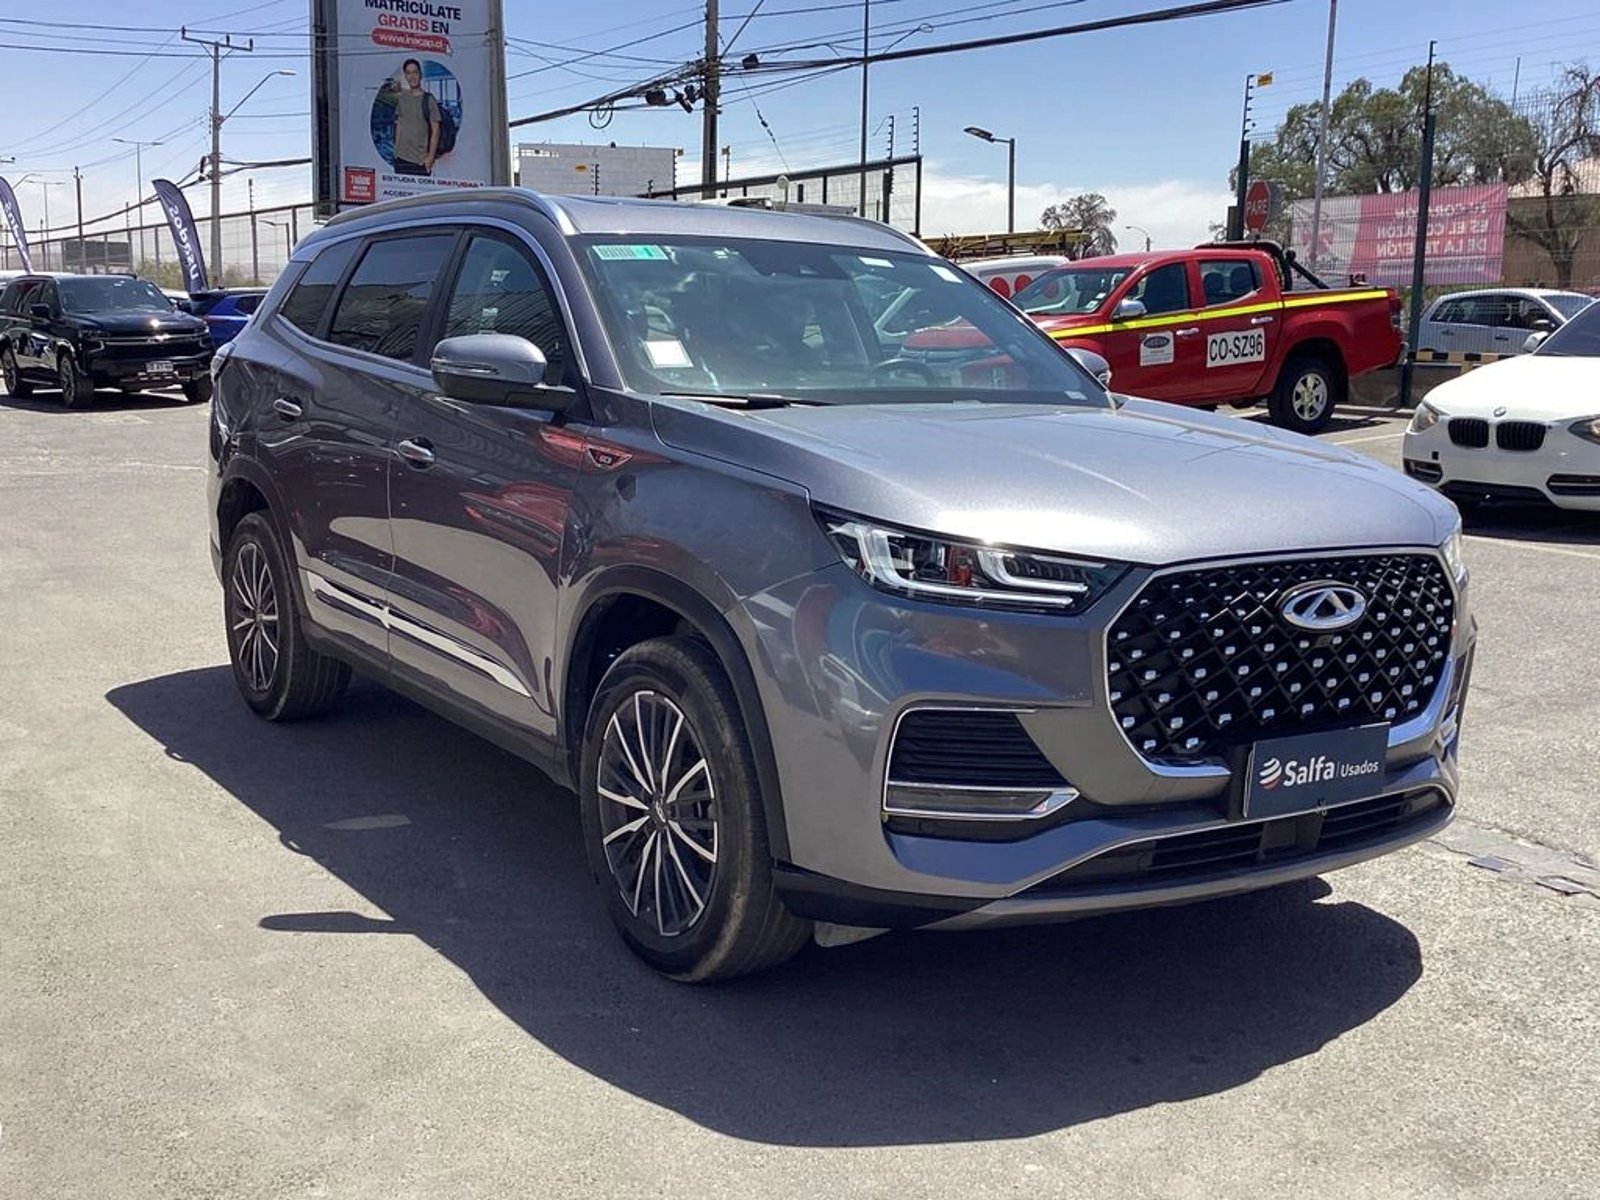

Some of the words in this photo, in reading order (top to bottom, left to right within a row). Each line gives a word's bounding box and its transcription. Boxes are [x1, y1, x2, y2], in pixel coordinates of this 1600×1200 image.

[365, 0, 461, 20] MATRICÚLATE
[378, 13, 428, 31] GRATIS
[431, 21, 449, 34] EN
[1246, 199, 1267, 215] PARE
[1209, 334, 1263, 361] CO-SZ96
[1283, 755, 1335, 787] Salfa
[1341, 760, 1379, 777] Usados
